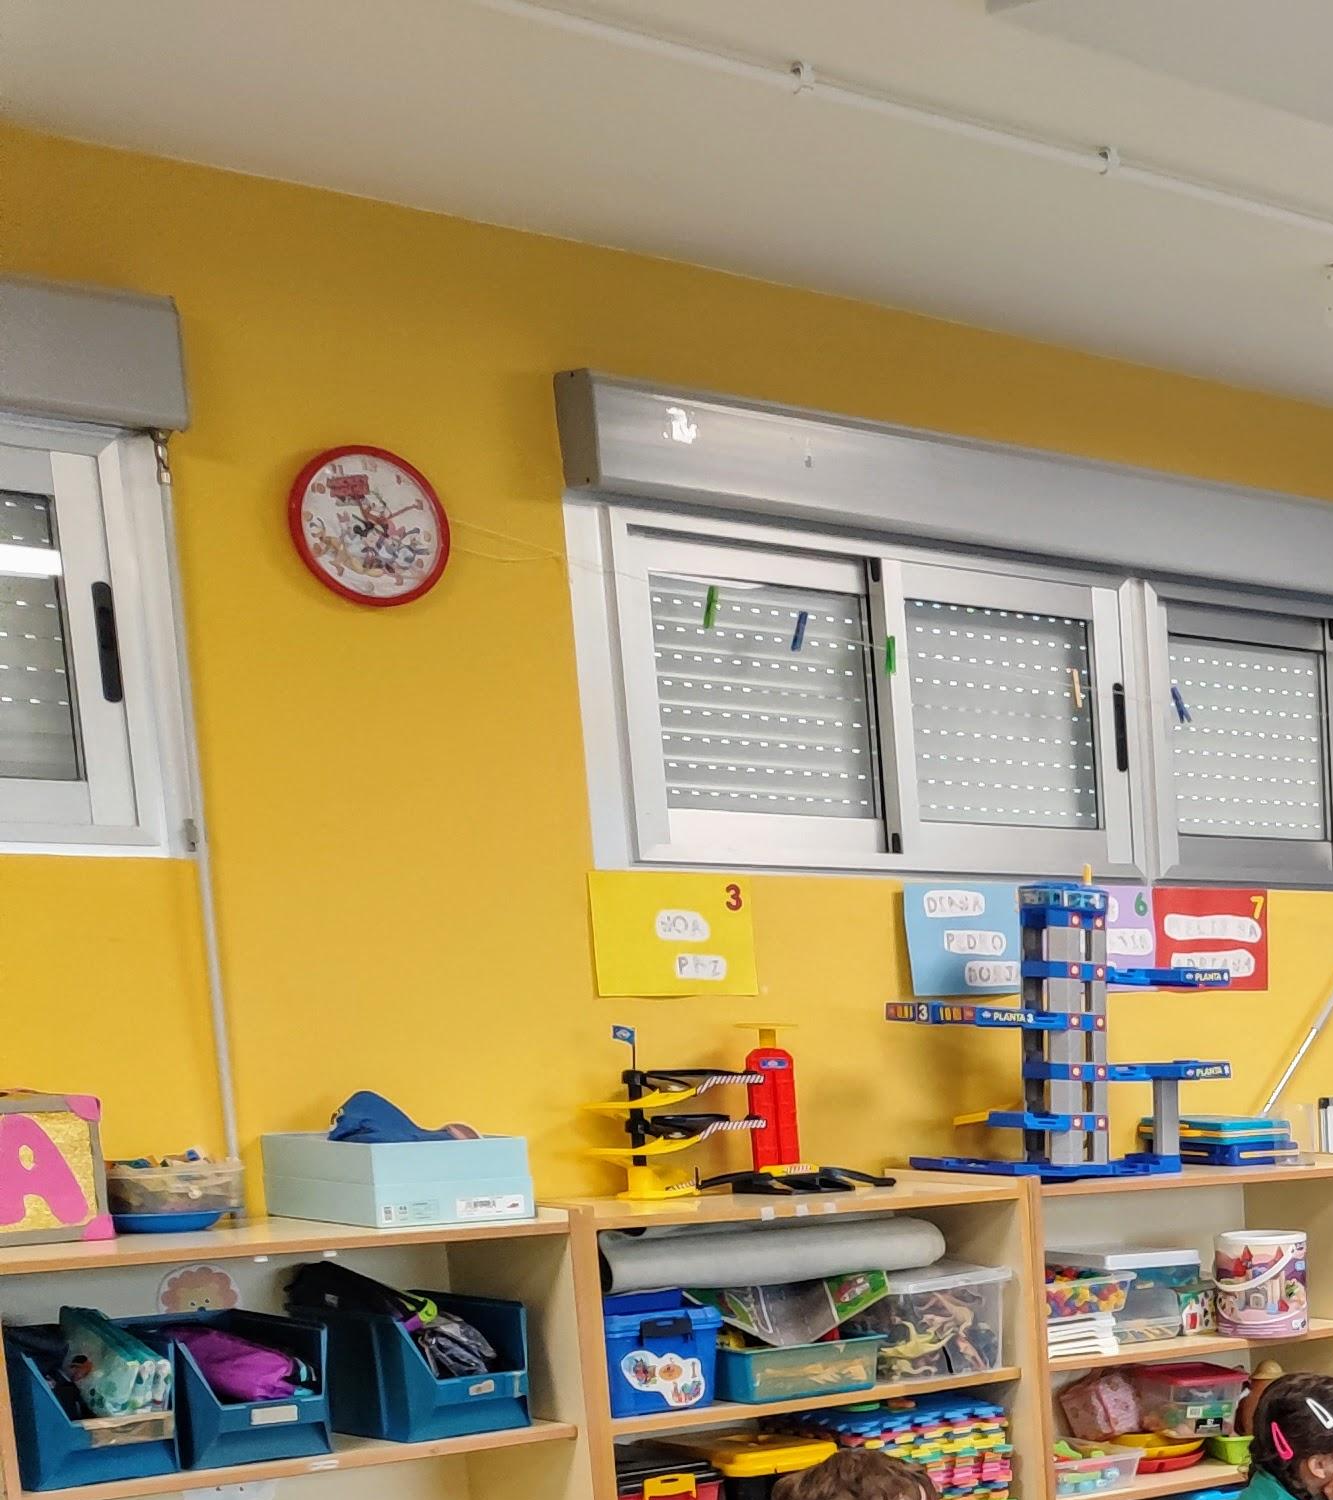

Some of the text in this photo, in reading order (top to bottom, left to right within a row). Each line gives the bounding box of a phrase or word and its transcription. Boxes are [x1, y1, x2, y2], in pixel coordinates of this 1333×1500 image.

[725, 883, 743, 911] 3
[1134, 892, 1149, 916] 6
[1250, 895, 1265, 919] 7
[918, 1003, 929, 1021] 3
[993, 1011, 1026, 1023] PLANTA
